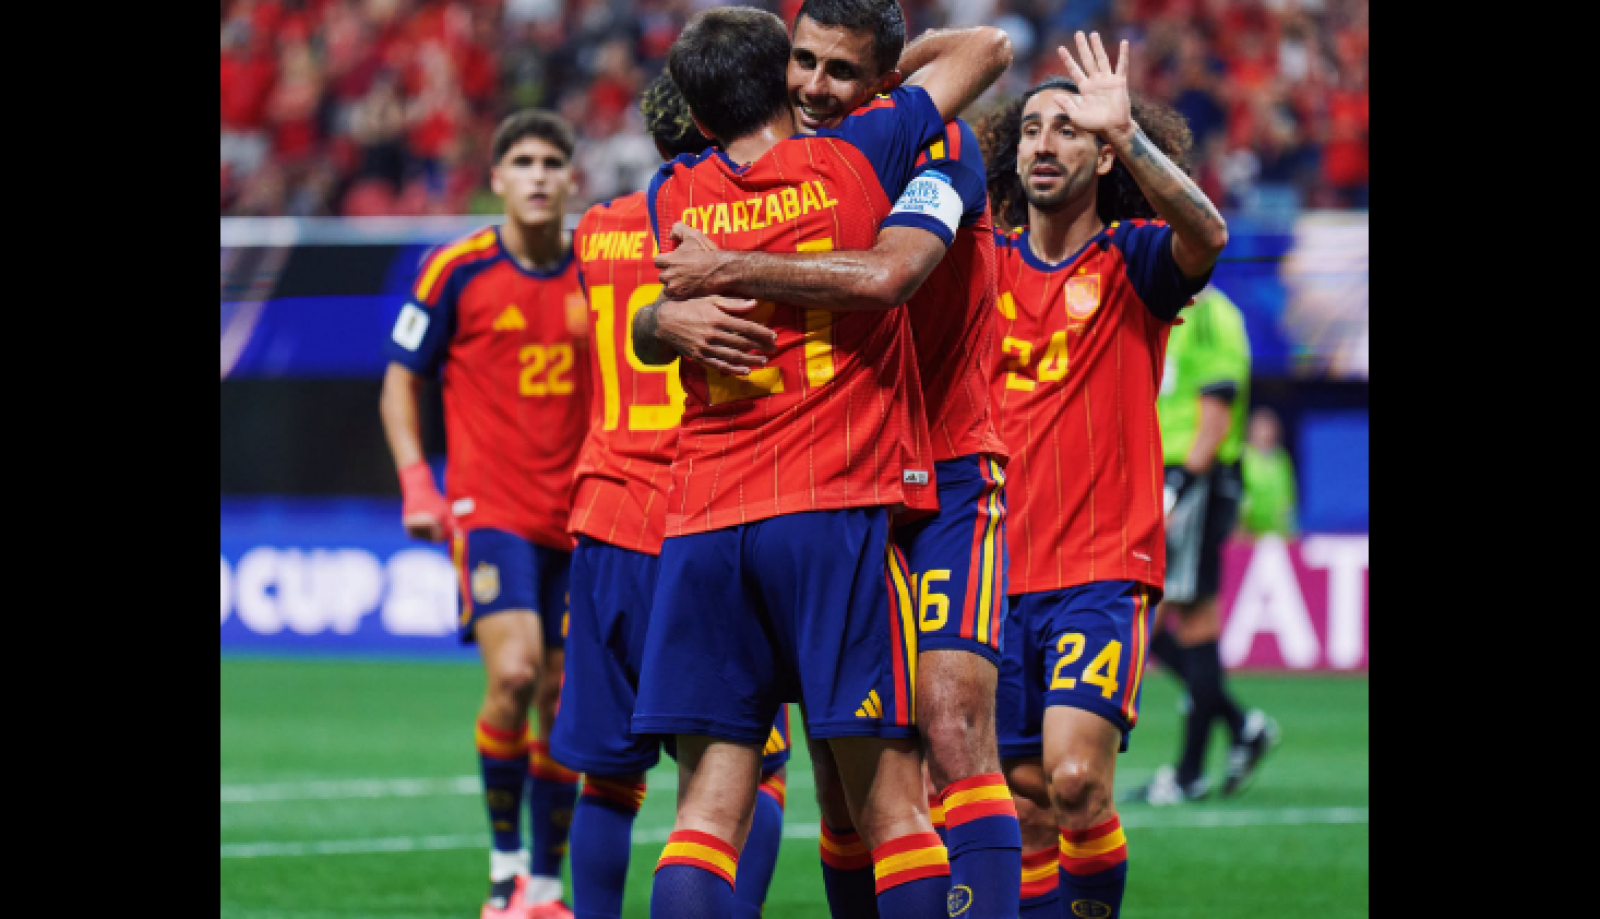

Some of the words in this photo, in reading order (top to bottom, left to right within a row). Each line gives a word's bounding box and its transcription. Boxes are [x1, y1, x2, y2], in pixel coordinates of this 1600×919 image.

[682, 181, 838, 235] OYARZABAL
[581, 231, 648, 263] LAMINE
[518, 342, 576, 398] 22
[590, 284, 687, 431] 19
[1001, 331, 1069, 391] 24
[235, 546, 384, 636] CUP
[1219, 532, 1369, 670] AT
[1050, 632, 1123, 700] 24
